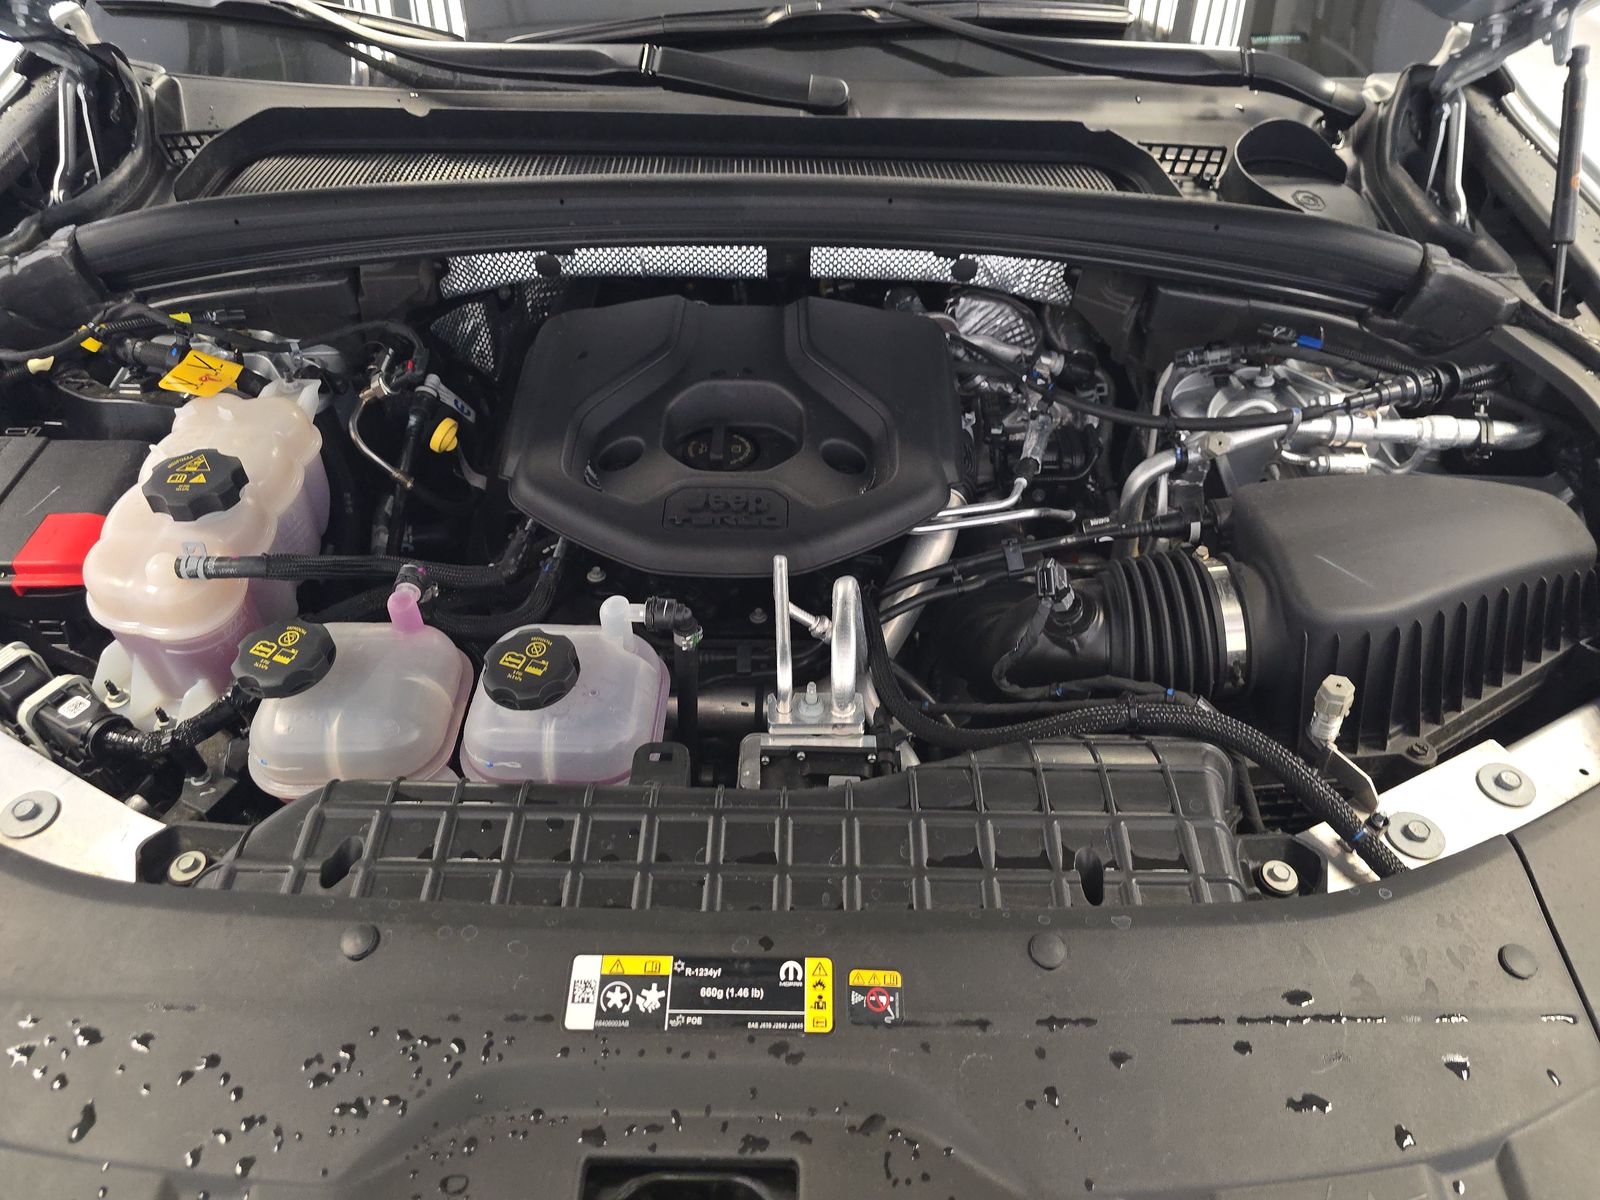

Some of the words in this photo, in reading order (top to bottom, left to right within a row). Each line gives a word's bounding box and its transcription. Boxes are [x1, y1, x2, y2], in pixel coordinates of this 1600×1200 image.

[687, 494, 771, 516] Jeep
[685, 967, 722, 978] R-1234yf
[700, 987, 724, 1000] 660g
[726, 987, 749, 1000] (1.46
[751, 987, 764, 1000] lb)
[687, 1016, 702, 1025] POE
